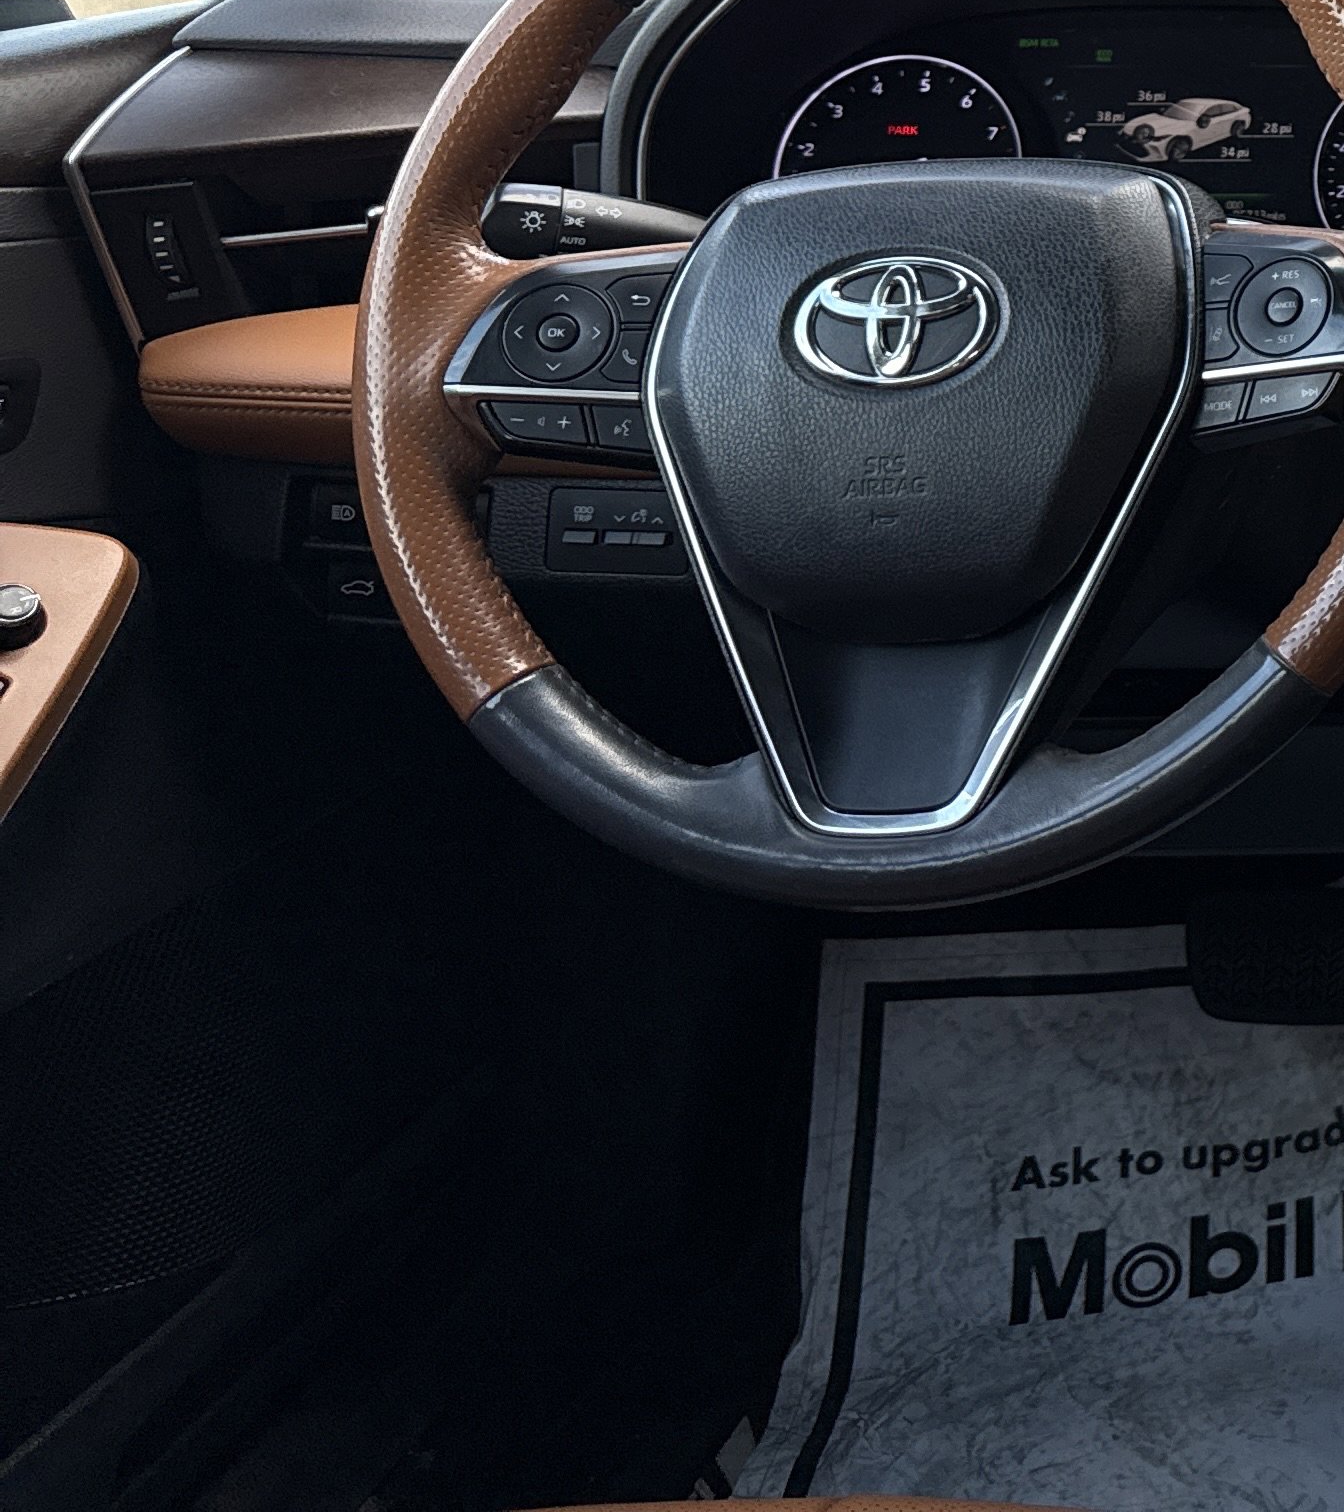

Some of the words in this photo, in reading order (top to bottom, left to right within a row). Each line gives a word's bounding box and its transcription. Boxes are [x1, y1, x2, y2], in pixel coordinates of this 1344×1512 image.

[871, 81, 883, 95] 4
[919, 78, 931, 92] 5
[960, 95, 973, 109] 6
[1137, 91, 1153, 101] 36
[1154, 91, 1167, 102] psi
[833, 104, 844, 118] 3
[1096, 111, 1112, 122] 38
[1113, 111, 1126, 123] psi
[887, 125, 919, 136] PARK
[987, 127, 998, 140] 7
[1262, 122, 1278, 133] 28
[1279, 122, 1293, 135] psi
[803, 143, 814, 156] 2
[1221, 147, 1235, 157] 34
[1236, 147, 1250, 159] psi
[560, 236, 586, 246] AUTO
[1282, 270, 1299, 279] RES
[1270, 301, 1297, 309] CANCEL
[547, 327, 565, 337] OK
[1277, 334, 1294, 343] SET
[1205, 400, 1232, 411] MODE
[864, 455, 906, 475] SRS
[842, 475, 929, 499] AIRBAG
[1010, 1144, 1101, 1193] Ask
[1118, 1144, 1164, 1183] to
[1008, 1194, 1316, 1328] Mobil
